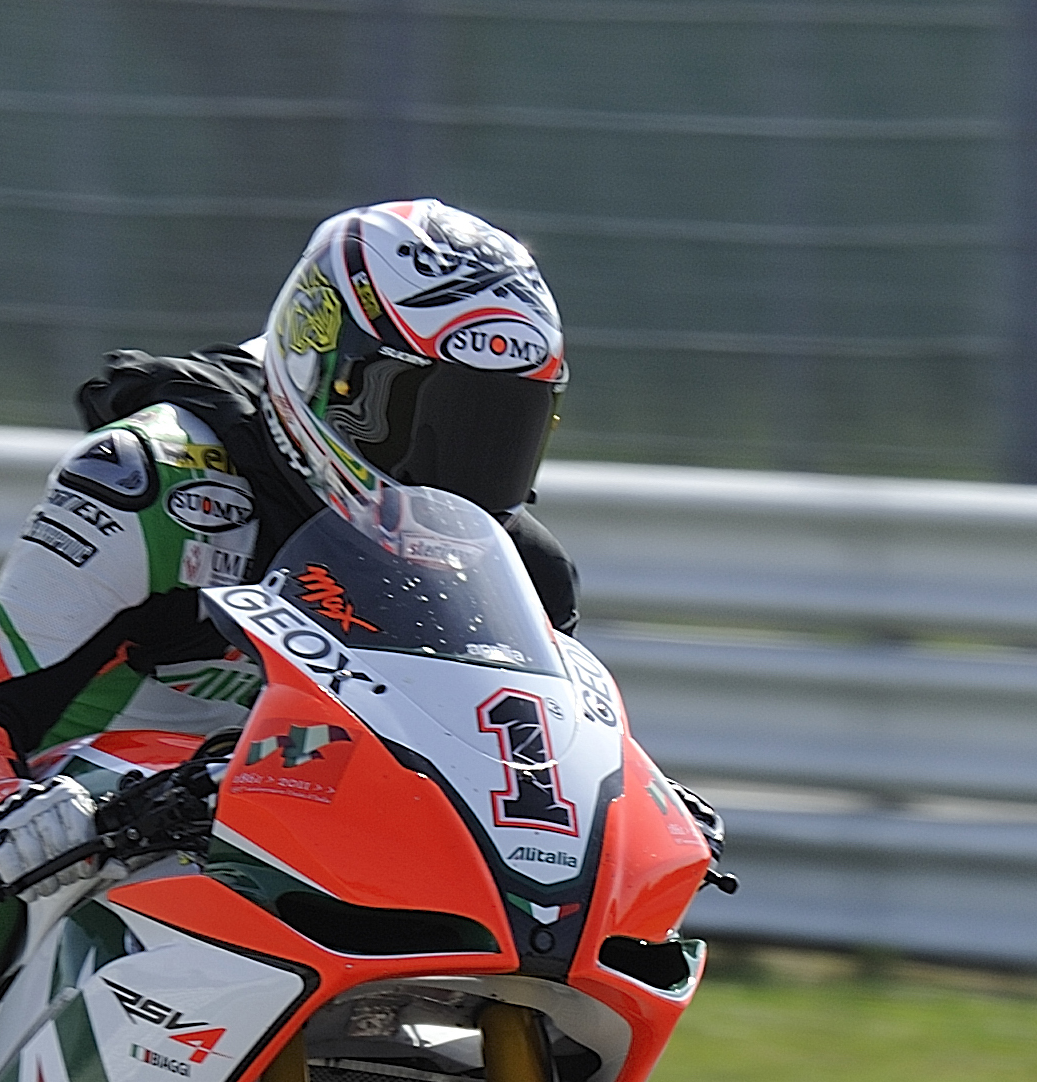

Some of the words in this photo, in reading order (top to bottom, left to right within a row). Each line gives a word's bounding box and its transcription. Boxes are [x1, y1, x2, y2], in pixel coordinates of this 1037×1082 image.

[453, 329, 546, 364] SUOMY
[172, 490, 251, 525] SUOMY
[221, 588, 374, 694] GEOX
[476, 687, 579, 838] 1
[507, 846, 578, 868] Alitalia
[99, 976, 227, 1064] RSV4
[150, 1052, 192, 1078] BIAGGI
